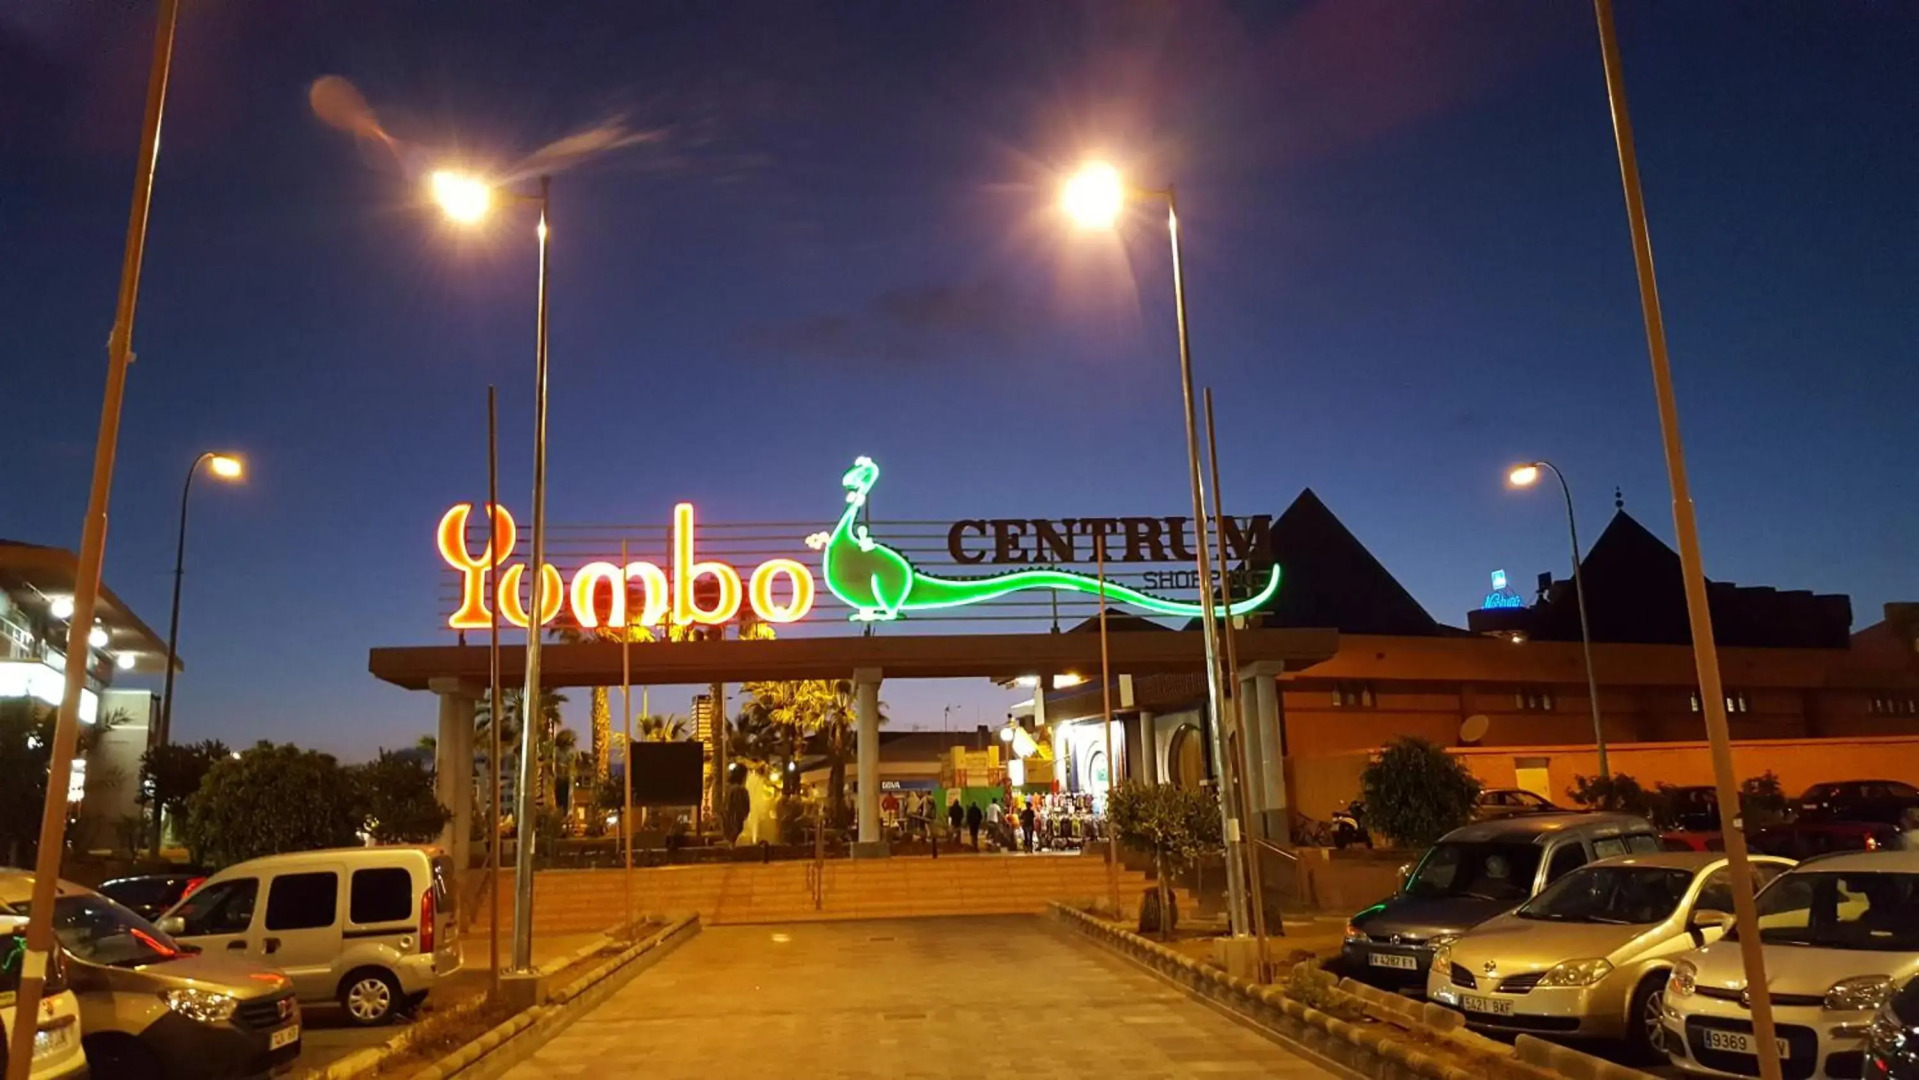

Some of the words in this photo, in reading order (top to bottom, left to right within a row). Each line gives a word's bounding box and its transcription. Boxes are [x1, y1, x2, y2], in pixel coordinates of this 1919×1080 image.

[948, 516, 1272, 564] CENTRUM
[437, 503, 815, 628] Yumbo
[882, 781, 900, 789] BBVA
[1465, 997, 1487, 1011] 5421
[1712, 1033, 1748, 1050] 9369
